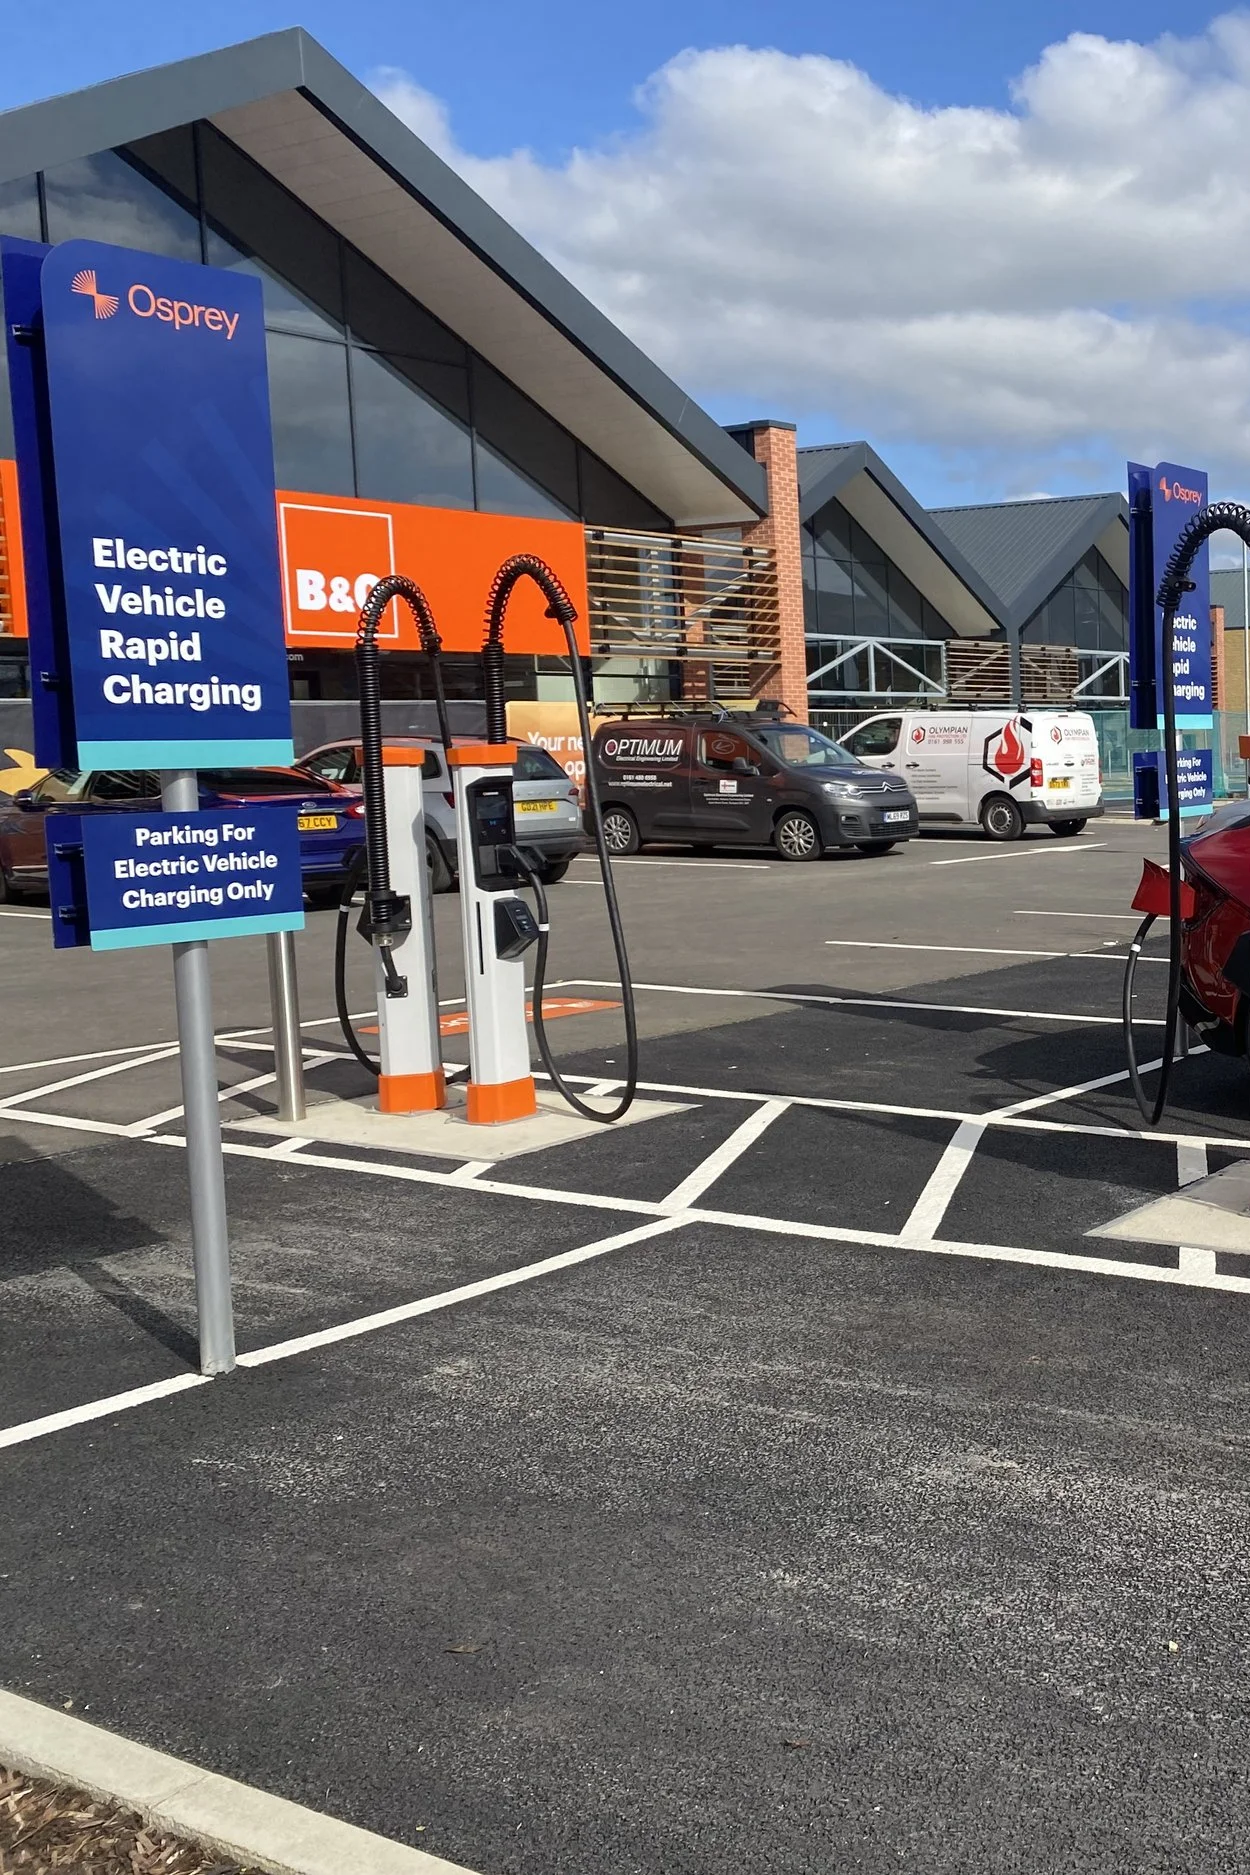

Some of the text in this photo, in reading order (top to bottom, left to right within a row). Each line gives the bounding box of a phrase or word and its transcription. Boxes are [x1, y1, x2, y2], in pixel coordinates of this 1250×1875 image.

[128, 284, 239, 340] Osprey
[1173, 482, 1202, 507] Osprey
[93, 537, 228, 576] Electric
[94, 583, 226, 619] Vehicle
[99, 629, 202, 667] Rapid
[103, 674, 262, 712] Charging
[527, 731, 566, 752] Your
[928, 726, 968, 734] OLYMPIAN
[604, 739, 684, 756] OPTIMUM
[1192, 756, 1202, 767] For
[1187, 771, 1208, 783] Vehicle
[1193, 786, 1206, 798] Only
[313, 817, 332, 827] CCY
[135, 823, 256, 847] Parking For
[114, 850, 278, 879] Electric Vehicle
[122, 880, 275, 909] Charging Only
